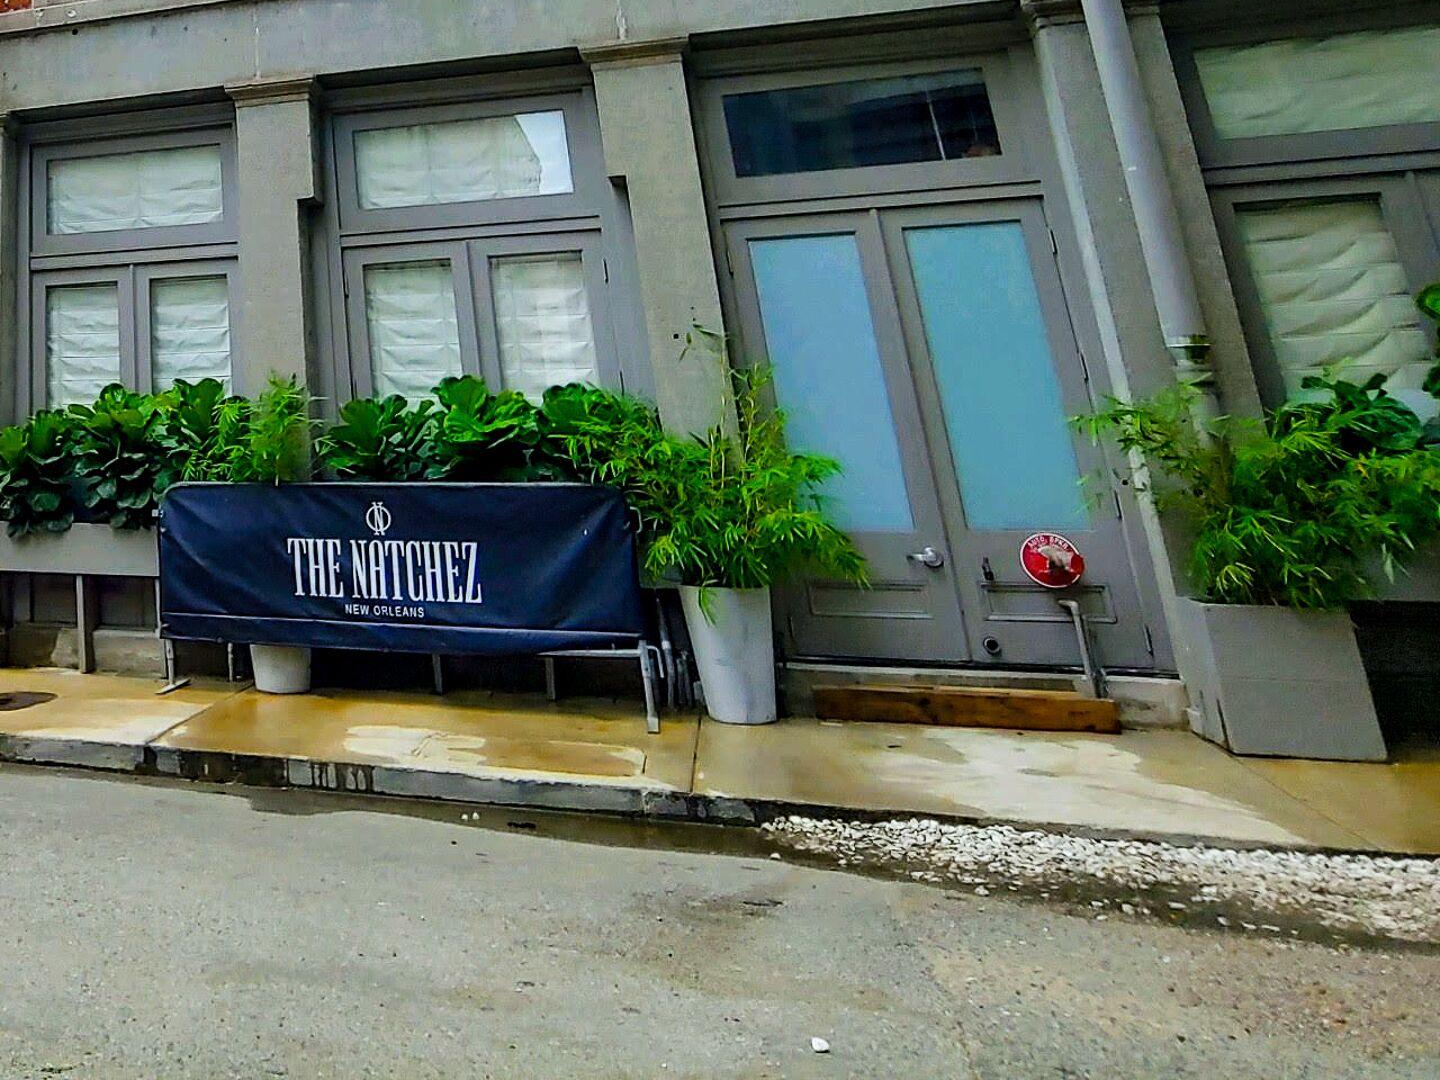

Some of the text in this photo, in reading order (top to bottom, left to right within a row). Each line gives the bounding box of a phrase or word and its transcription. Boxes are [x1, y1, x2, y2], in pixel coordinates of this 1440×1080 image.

[287, 538, 482, 604] THE NATCHEZ
[345, 604, 425, 618] NEW ORLEANS
